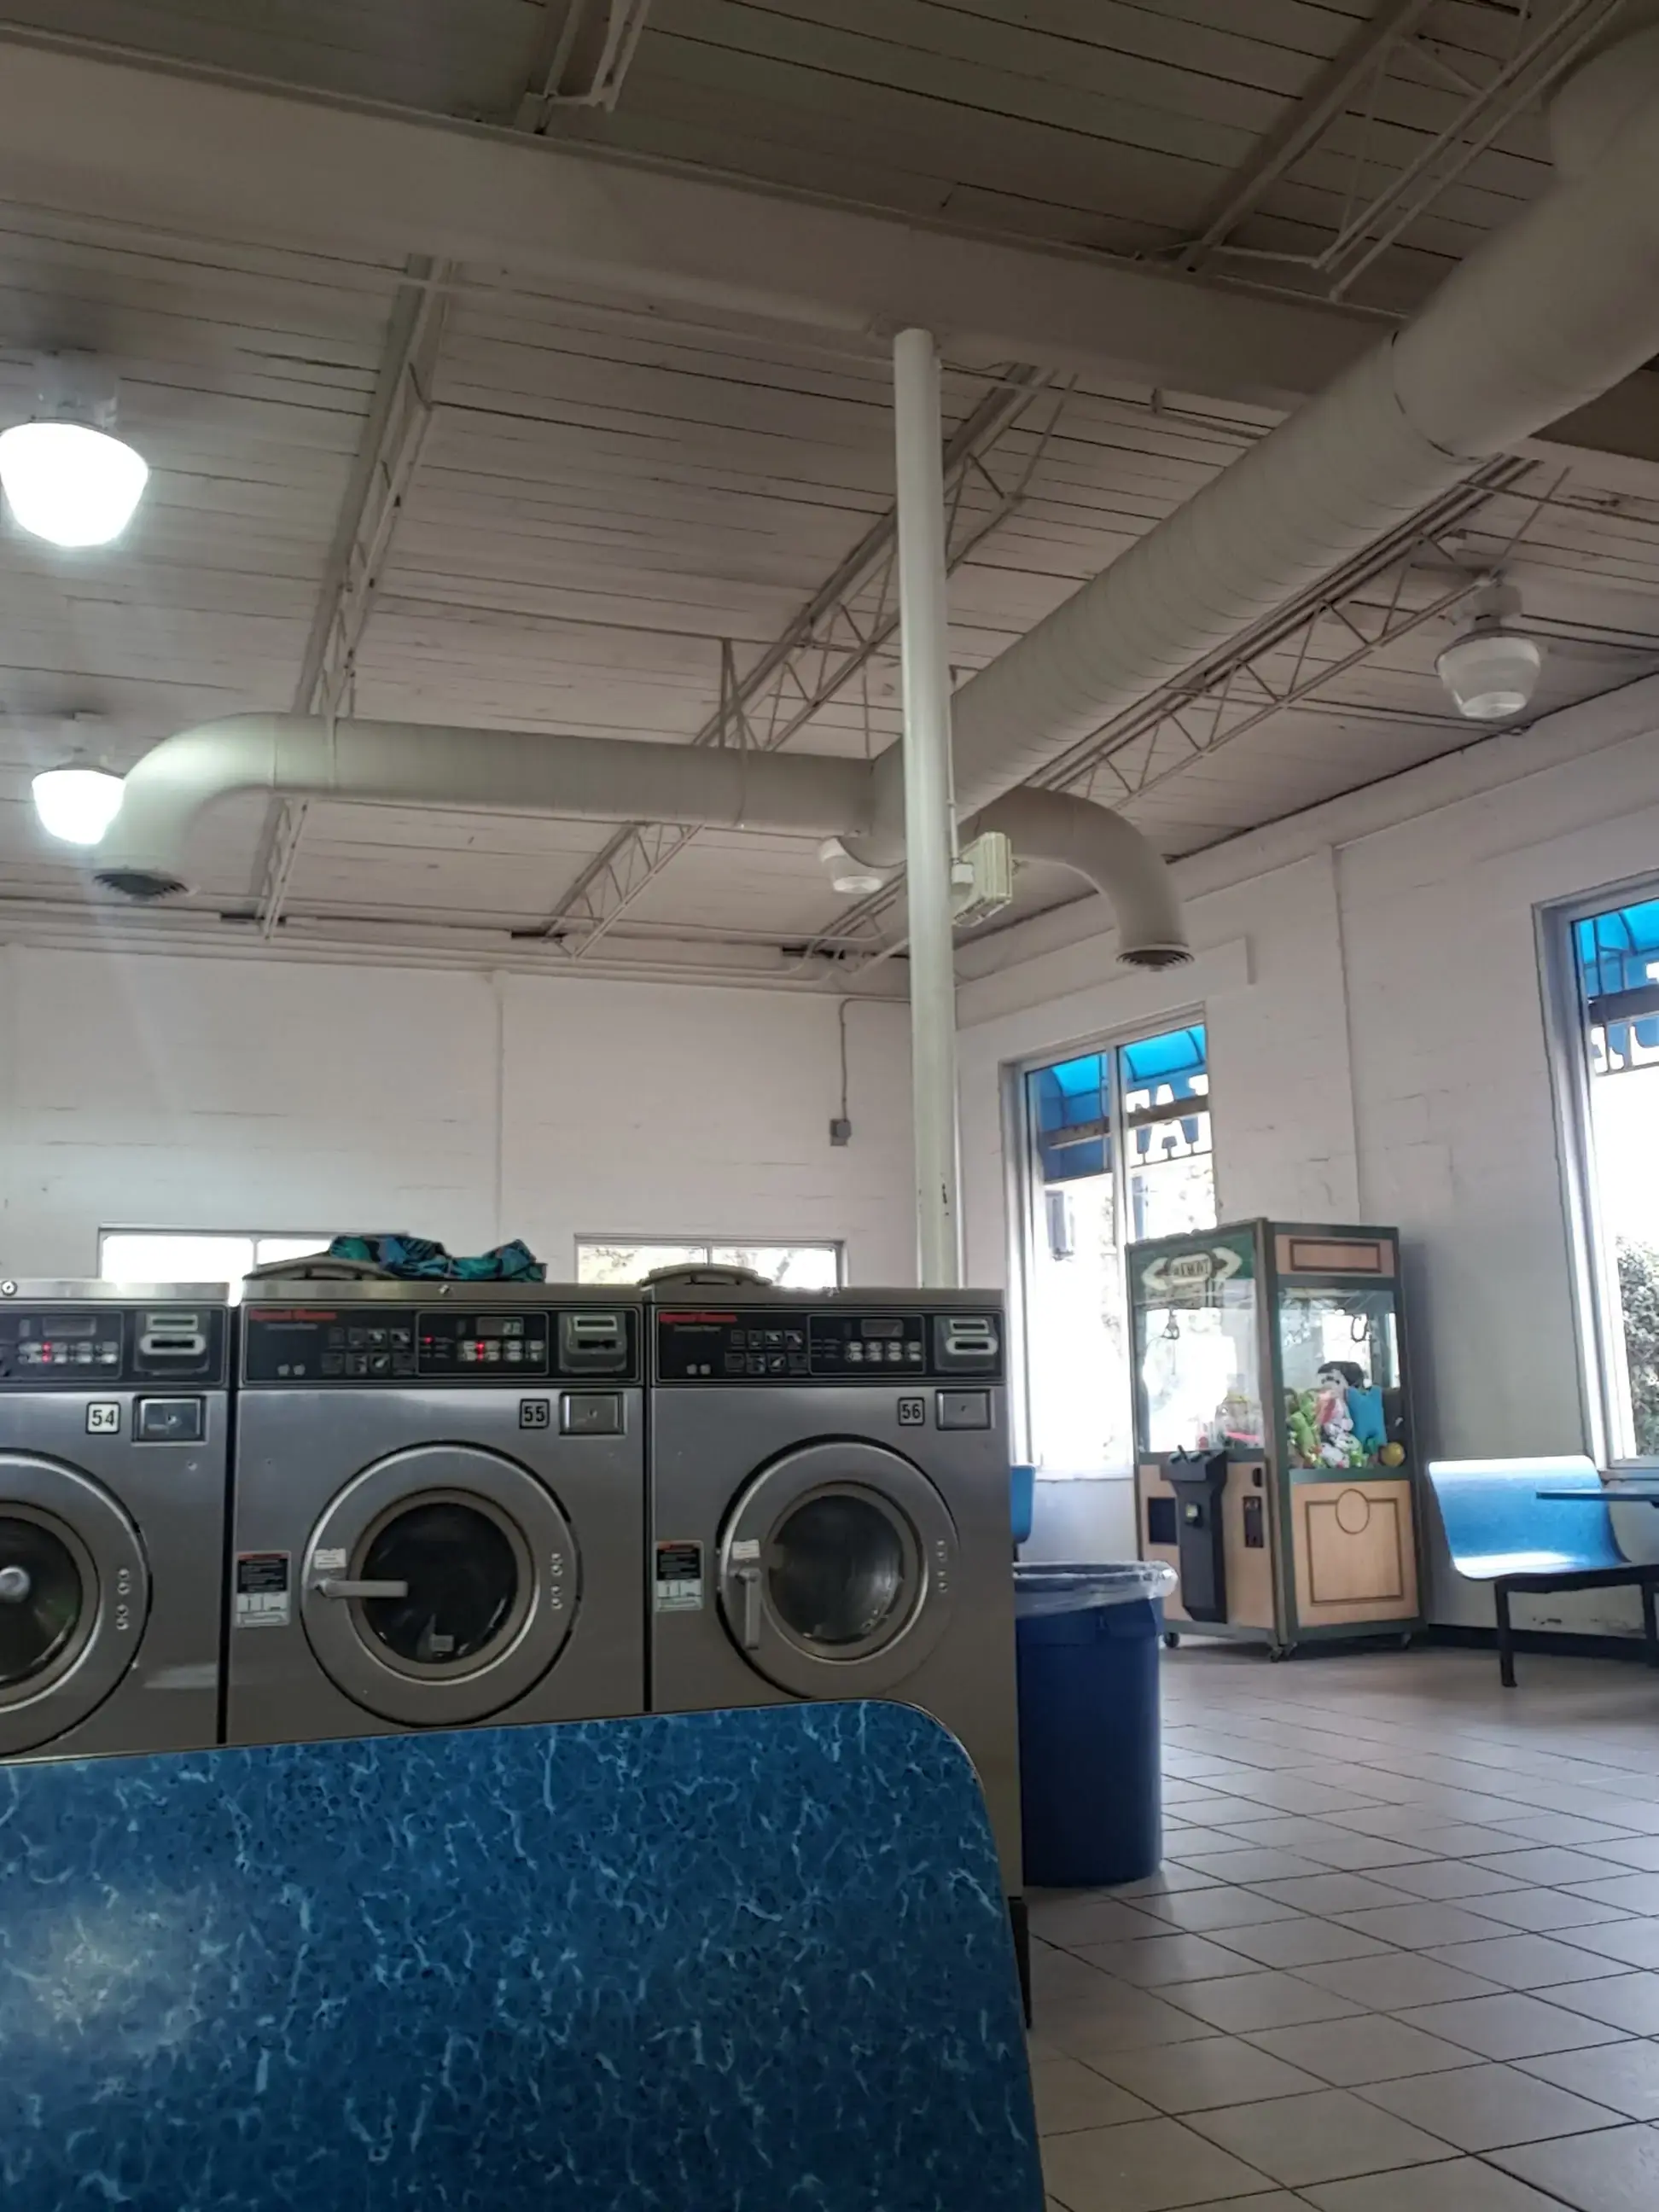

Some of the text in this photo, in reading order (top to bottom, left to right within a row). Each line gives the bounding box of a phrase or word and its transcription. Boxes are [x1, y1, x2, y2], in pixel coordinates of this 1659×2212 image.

[91, 1409, 115, 1426] 54
[523, 1406, 546, 1423] 55
[901, 1403, 922, 1420] 56
